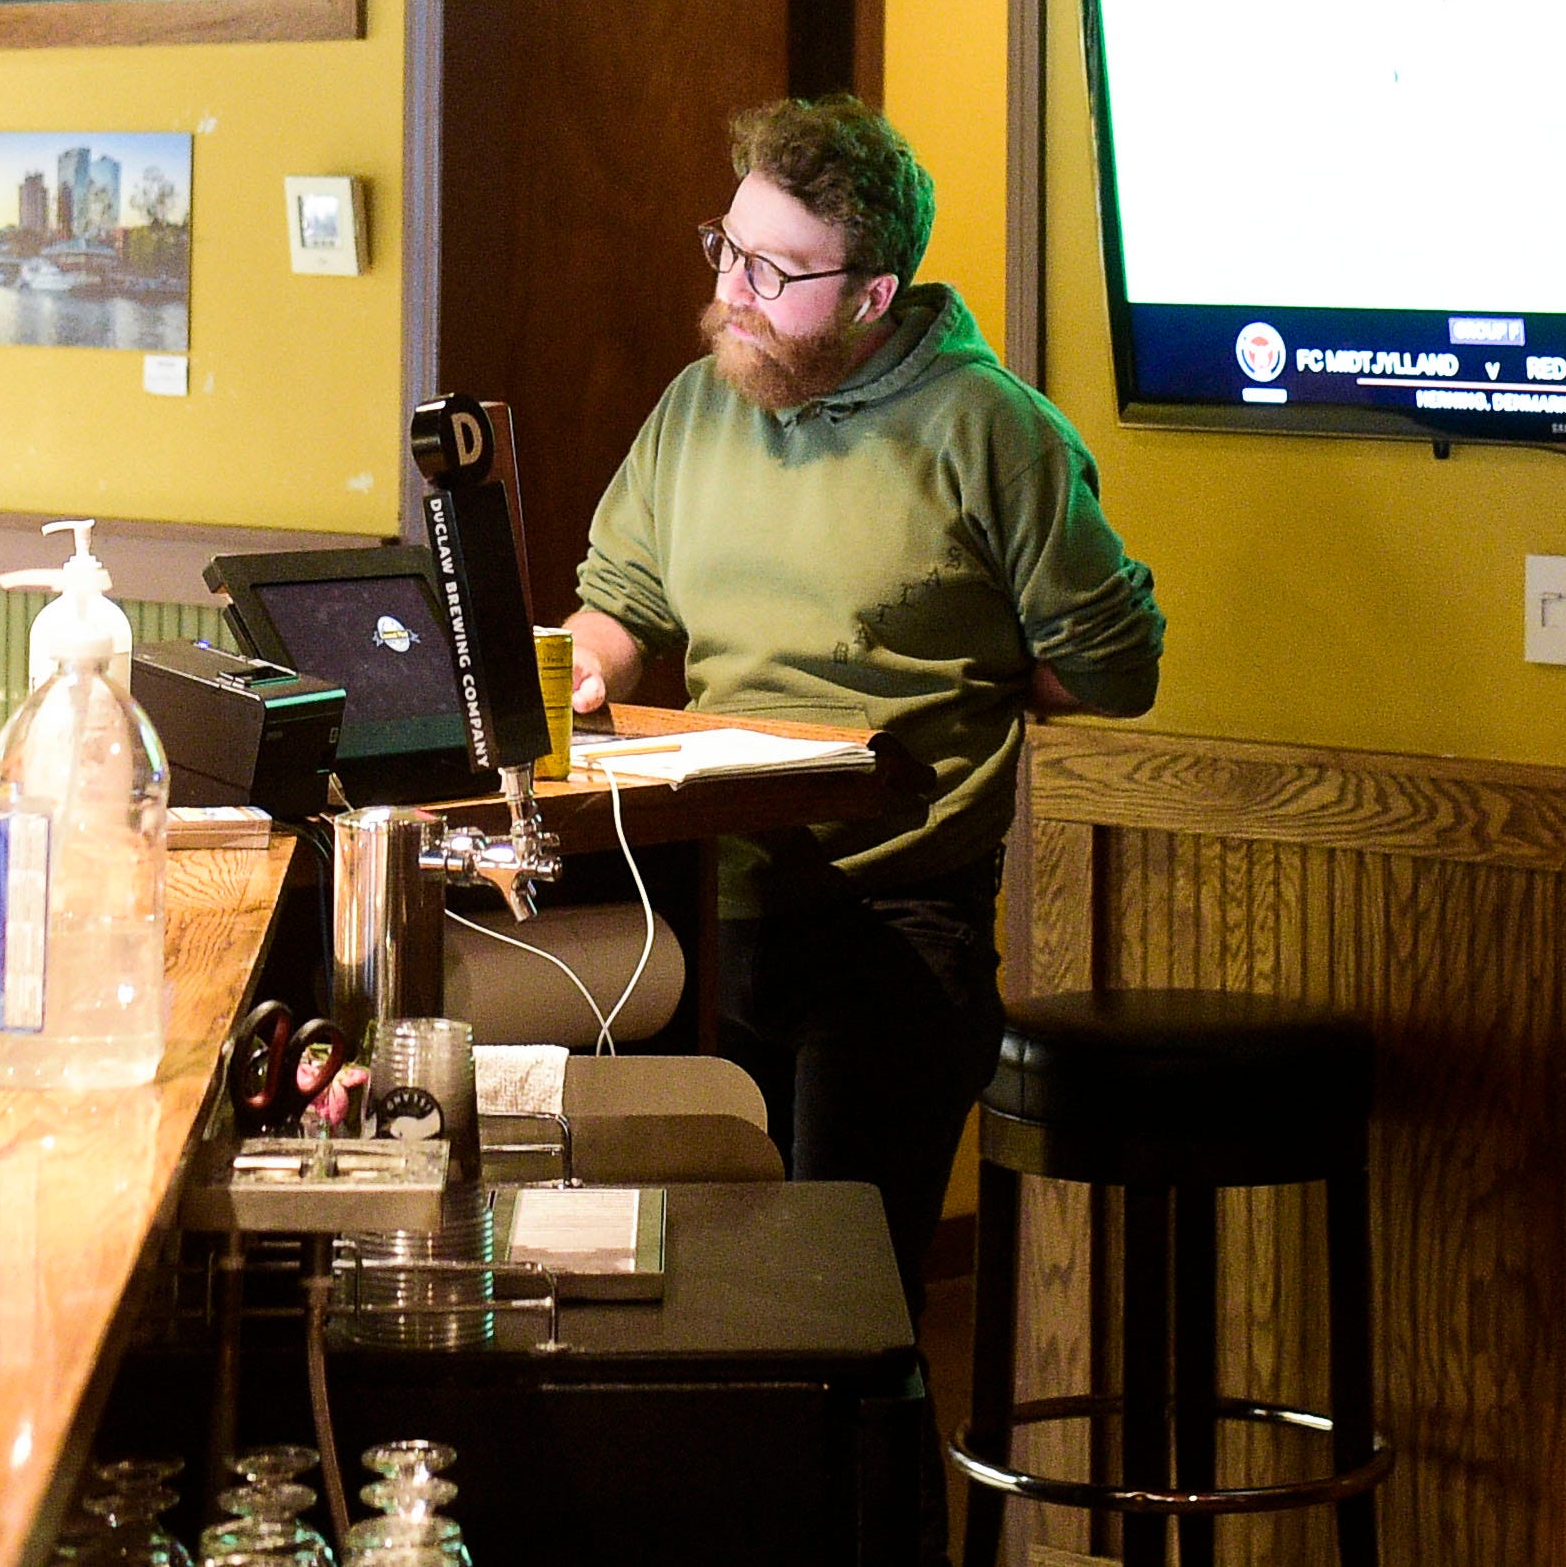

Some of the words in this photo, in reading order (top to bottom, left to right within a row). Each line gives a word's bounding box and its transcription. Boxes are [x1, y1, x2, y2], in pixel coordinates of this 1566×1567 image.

[1296, 349, 1324, 372] FC
[1325, 350, 1459, 376] MIDTJYLLAND
[450, 411, 483, 467] D
[429, 498, 455, 575] DUCLAW
[444, 580, 471, 667] BREWING
[462, 674, 490, 769] COMPANY
